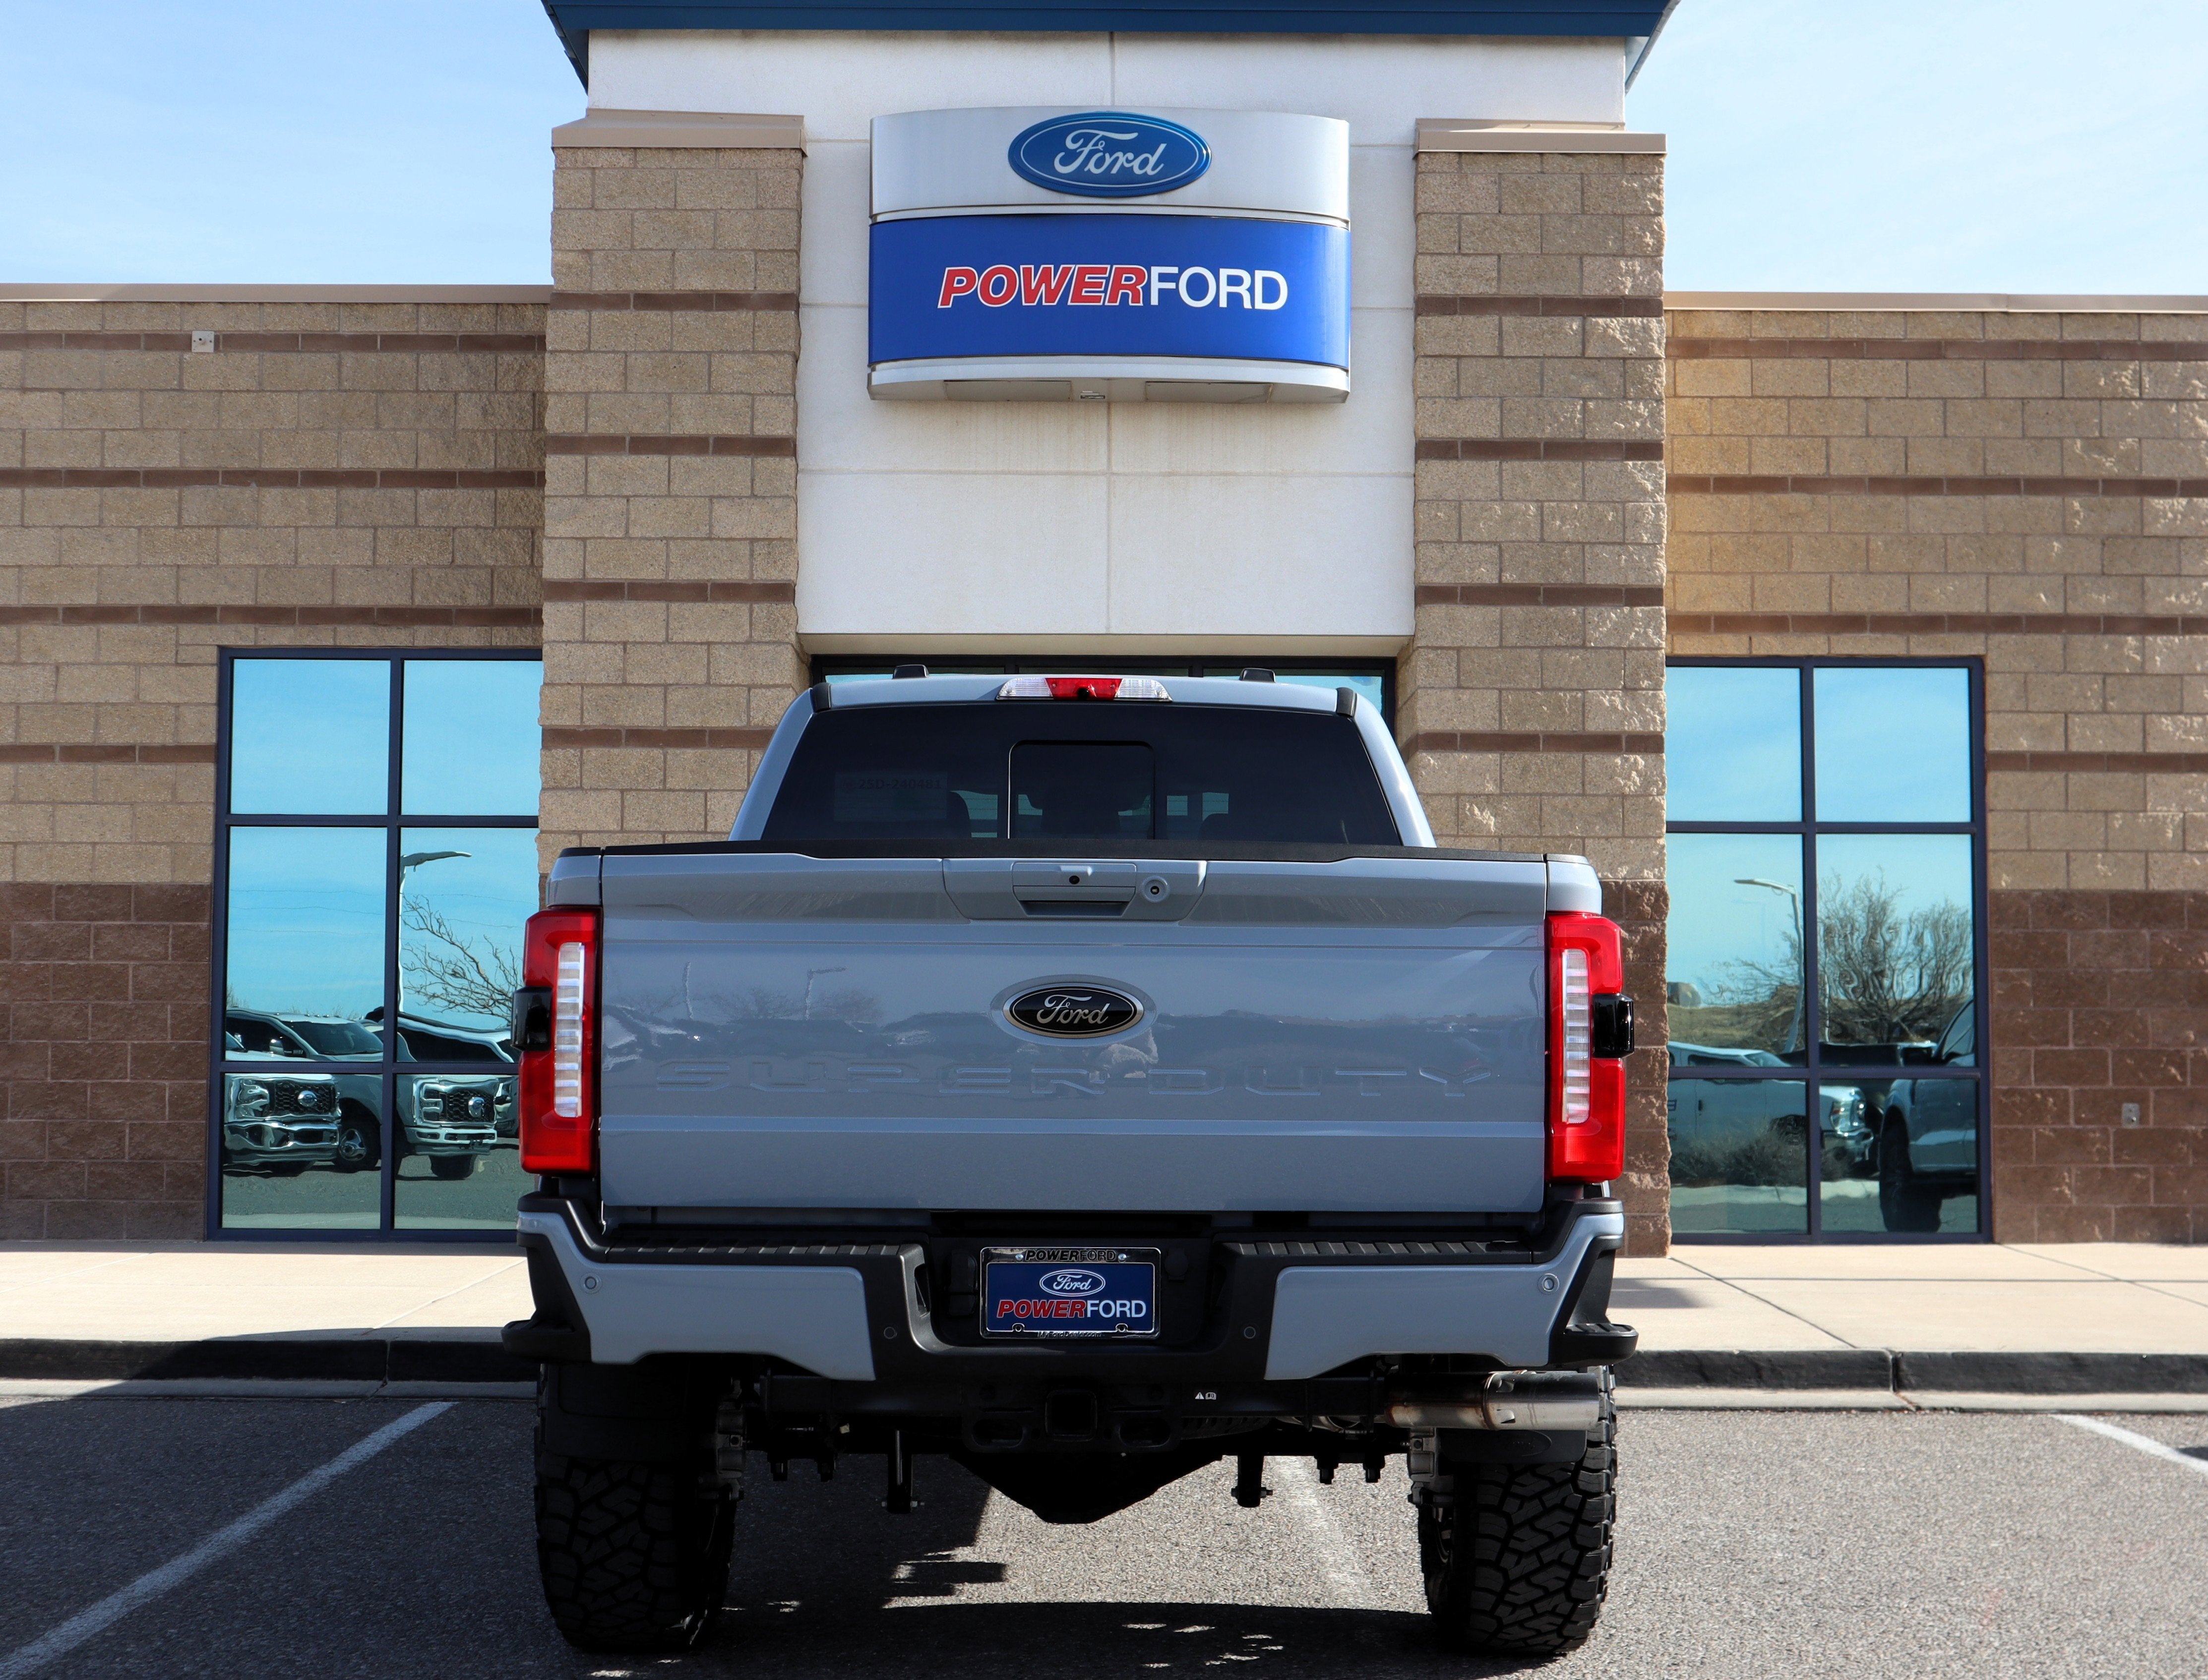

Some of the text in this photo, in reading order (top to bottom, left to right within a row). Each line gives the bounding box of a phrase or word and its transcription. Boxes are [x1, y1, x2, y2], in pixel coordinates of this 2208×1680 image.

[1053, 128, 1167, 176] Ford
[937, 264, 1288, 310] POWERFORD
[1037, 994, 1110, 1024] Ford
[657, 1061, 1491, 1097] SUPER DUTY
[1052, 1274, 1092, 1290] Ford
[996, 1299, 1147, 1318] POWERFORD
